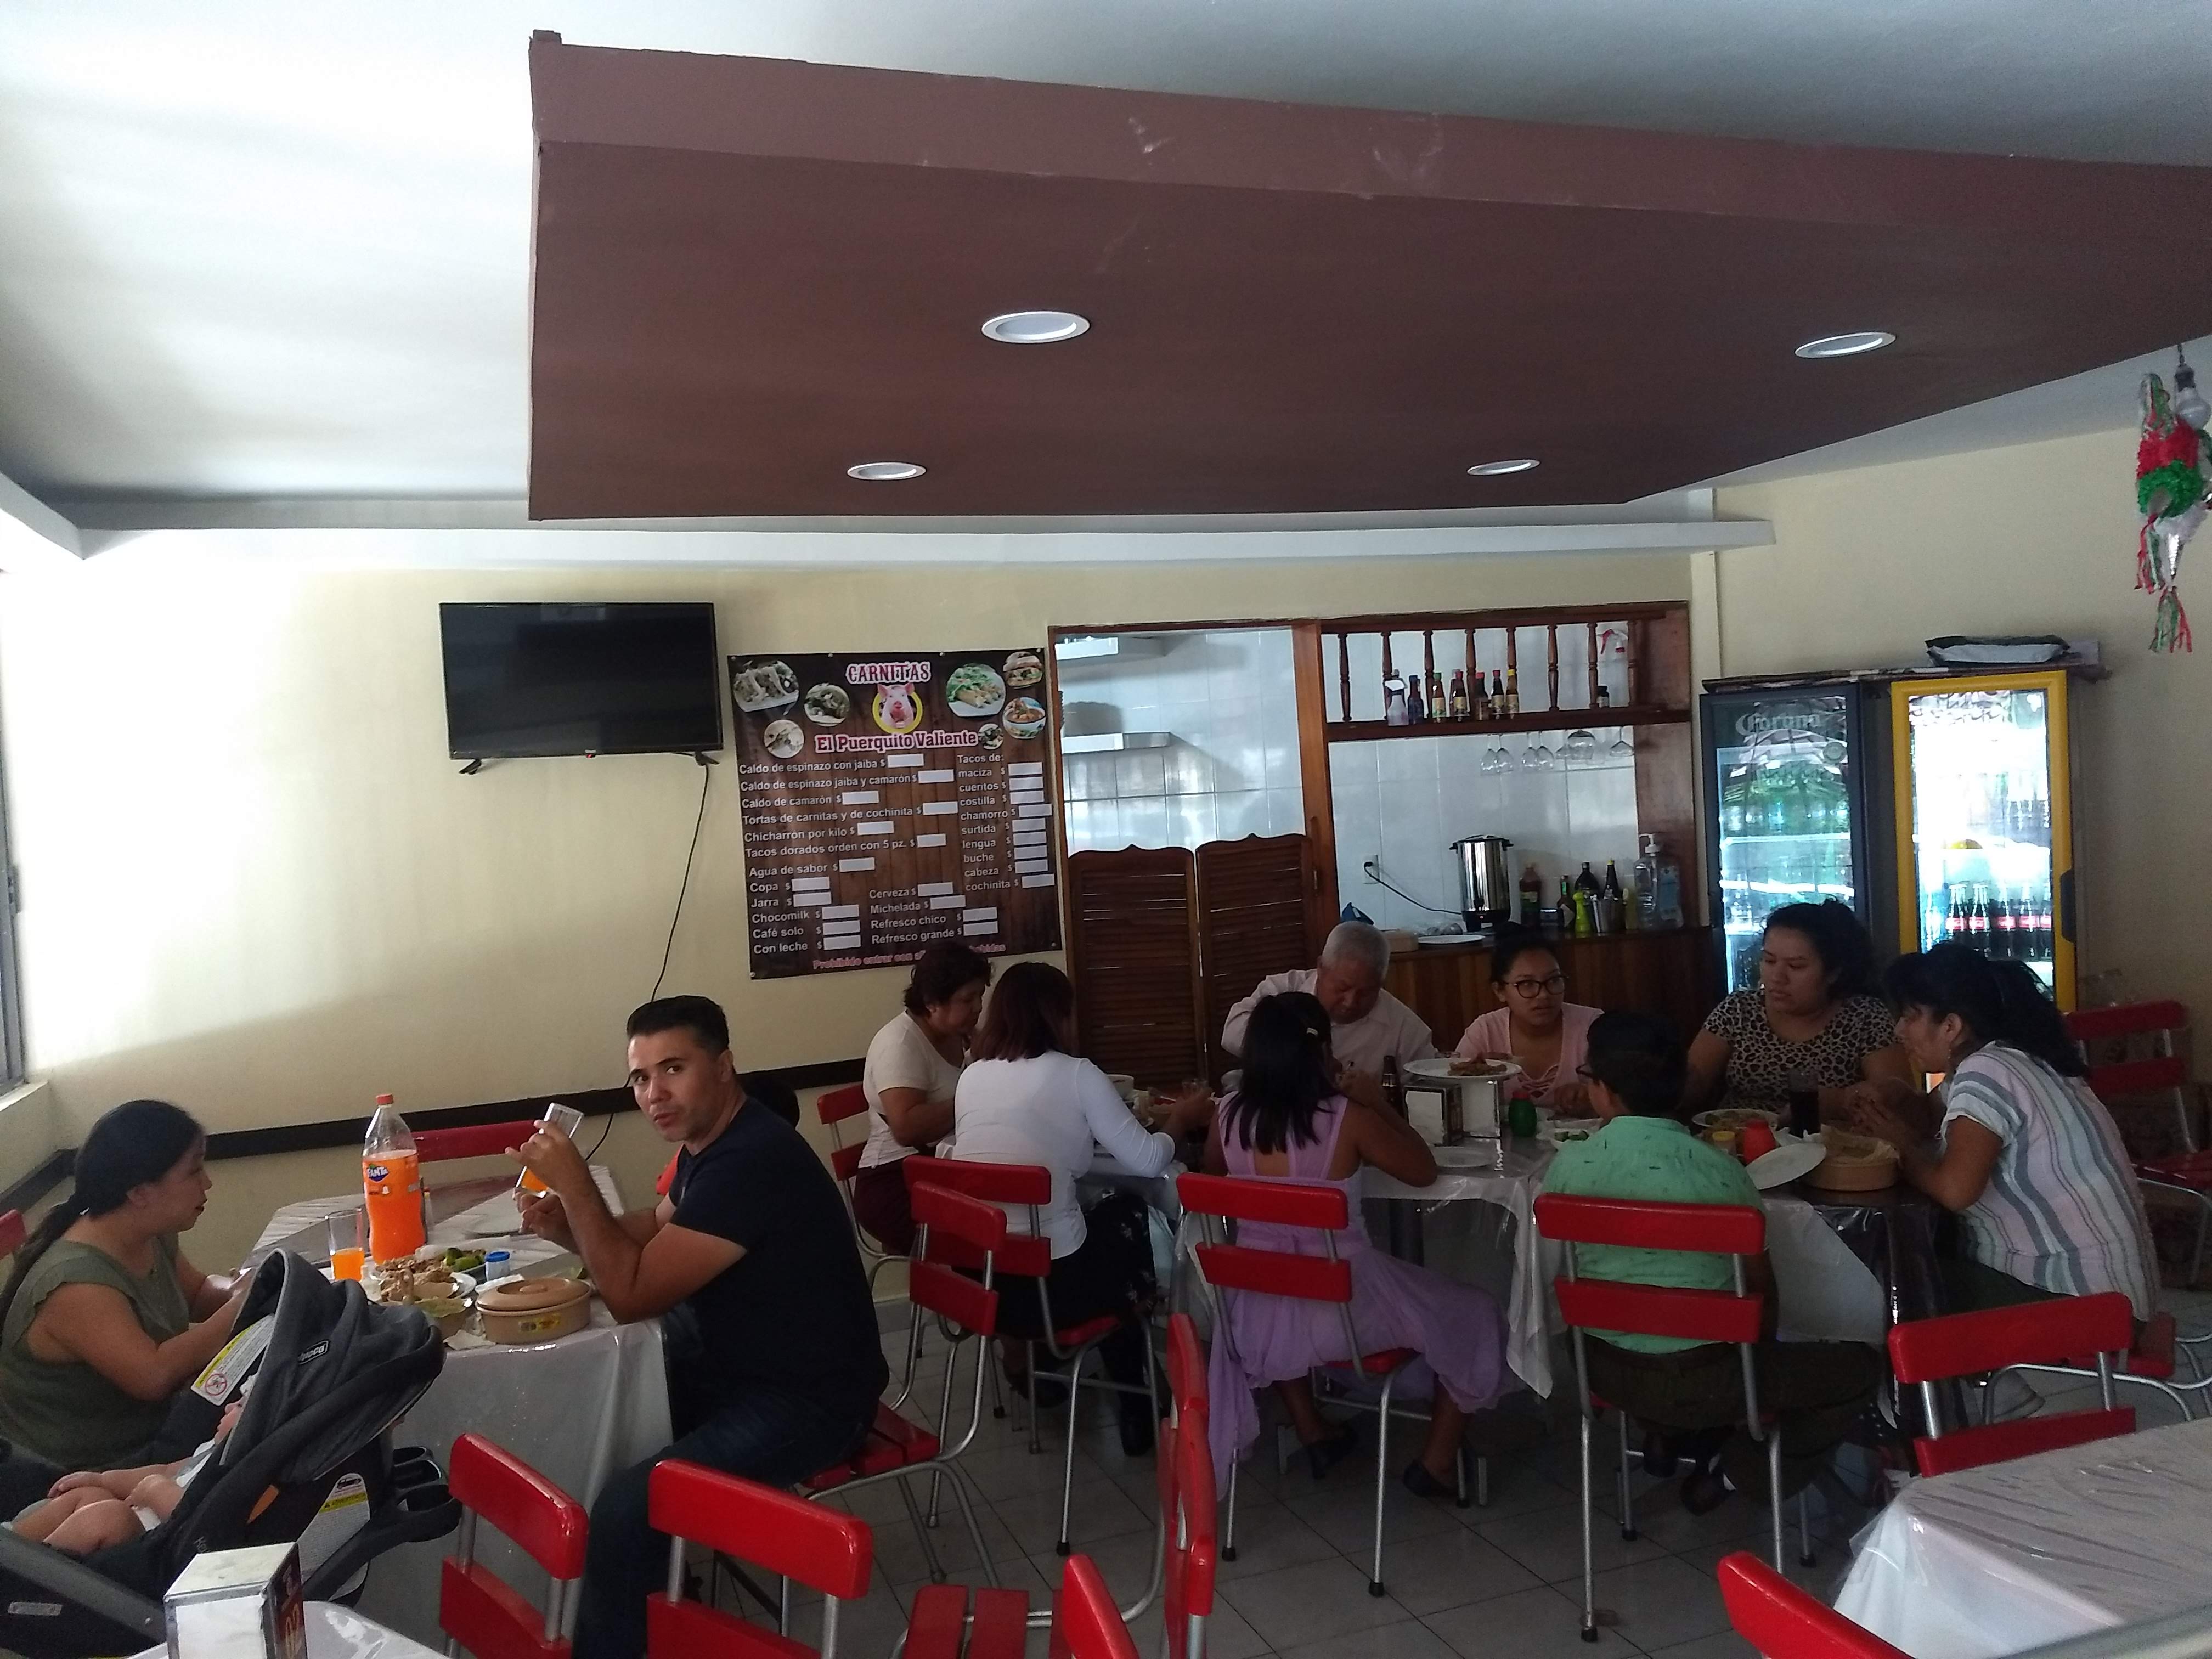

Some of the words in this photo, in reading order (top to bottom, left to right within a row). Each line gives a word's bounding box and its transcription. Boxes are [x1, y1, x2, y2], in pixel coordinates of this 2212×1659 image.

[848, 663, 930, 683] CARNITAS
[1735, 713, 1820, 736] Corona
[817, 736, 833, 752] El
[837, 733, 912, 753] Puerquito
[915, 732, 977, 747] Valiente
[957, 754, 985, 763] Tacos
[740, 764, 769, 774] Caldo
[772, 763, 784, 771] de
[787, 763, 831, 773] espinazo
[854, 759, 877, 771] jaiba
[741, 781, 770, 791] Caldo
[773, 780, 785, 789] de
[788, 780, 832, 789] espinazo
[834, 777, 858, 788] jaiba
[861, 778, 866, 787] y
[869, 774, 910, 784] camarón
[742, 798, 771, 808] Caldo
[774, 798, 786, 806] de
[789, 795, 832, 805] camarón
[960, 796, 995, 806] costilla
[743, 815, 776, 825] Tortas
[780, 814, 793, 822] de
[797, 812, 838, 821] carnitas
[850, 810, 862, 819] de
[866, 808, 913, 817] cochinita
[961, 811, 1008, 820] chamorro
[744, 830, 804, 842] Chicharrón
[808, 831, 825, 840] por
[828, 828, 847, 837] kilo
[962, 825, 996, 834] surtida
[746, 849, 777, 857] Tacos
[781, 845, 825, 855] dorados
[828, 843, 857, 852] orden
[883, 840, 889, 848] 5
[962, 840, 996, 850] lengua
[964, 853, 994, 862] buche
[749, 868, 777, 878] Agua
[781, 866, 793, 874] de
[797, 864, 827, 873] sabor
[964, 868, 999, 877] cabeza
[750, 883, 778, 893] Copa
[966, 880, 1010, 891] cochinita
[869, 889, 909, 899] Cerveza
[751, 899, 779, 908] Jarra
[871, 902, 920, 913] Michelada
[752, 911, 809, 923] Chocomilk
[871, 917, 916, 929] Refresco
[919, 915, 946, 925] chico
[753, 929, 777, 939] Café
[781, 927, 804, 936] solo
[872, 933, 917, 944] Refresco
[921, 929, 954, 941] grande
[754, 945, 776, 954] Con
[780, 942, 808, 952] leche
